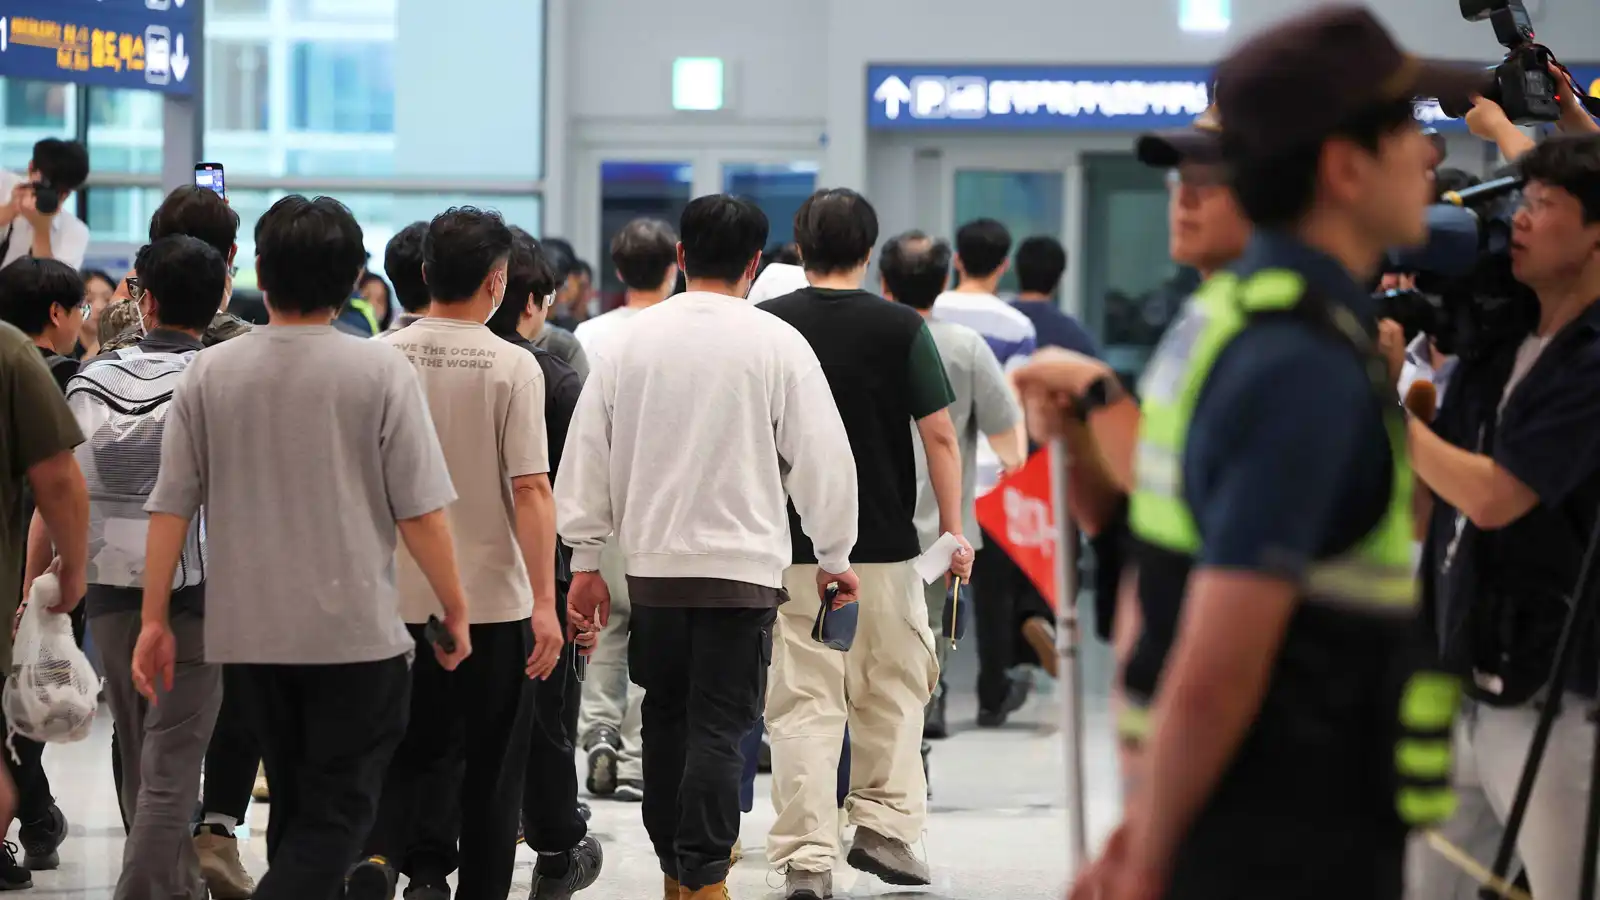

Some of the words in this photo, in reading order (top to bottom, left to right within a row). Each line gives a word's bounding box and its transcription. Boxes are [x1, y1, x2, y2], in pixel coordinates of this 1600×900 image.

[421, 345, 447, 355] THE
[451, 347, 496, 358] OCEAN
[419, 357, 443, 367] THE
[447, 359, 493, 369] WORLD
